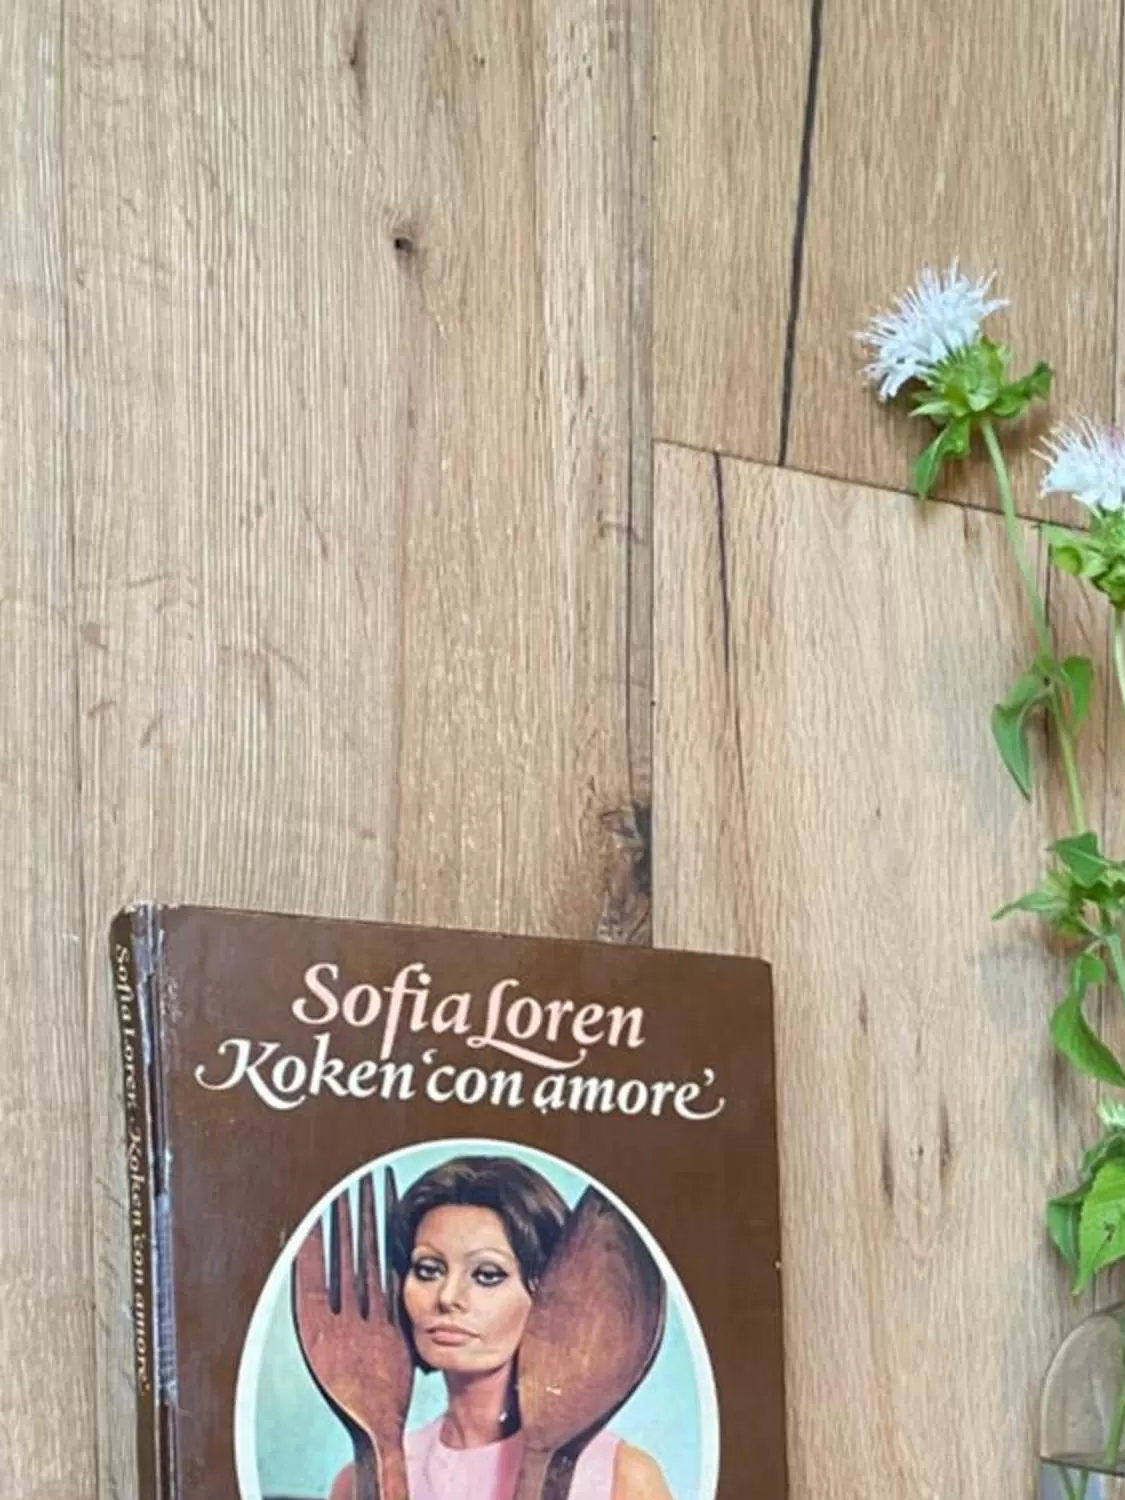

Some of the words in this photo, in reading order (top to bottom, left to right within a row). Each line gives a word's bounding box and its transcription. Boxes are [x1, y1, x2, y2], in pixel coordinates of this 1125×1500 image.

[115, 943, 134, 1020] Sofia
[292, 961, 473, 1060] Sofia
[466, 977, 645, 1069] Loren
[195, 1035, 413, 1112] Koken
